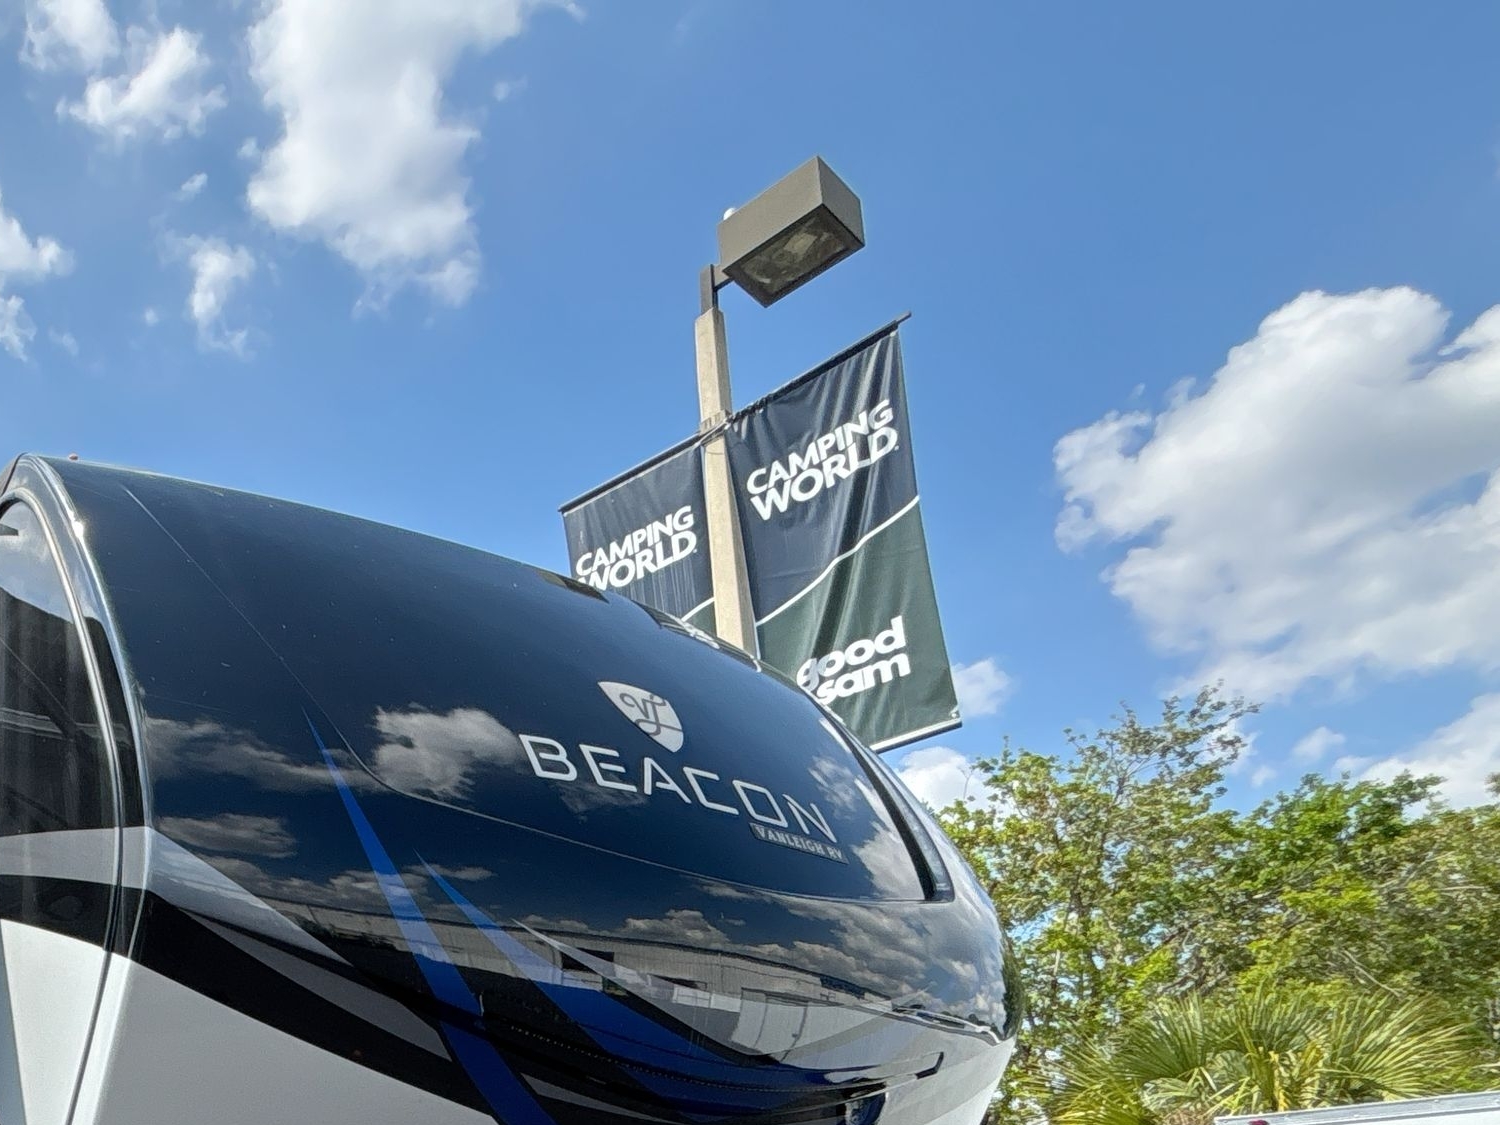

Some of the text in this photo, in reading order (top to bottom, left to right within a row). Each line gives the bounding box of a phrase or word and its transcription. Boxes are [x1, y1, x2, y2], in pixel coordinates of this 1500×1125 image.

[746, 399, 894, 495] CAMPING
[750, 427, 898, 521] WORLD
[575, 505, 695, 577] CAMPING
[577, 530, 697, 591] WORLD
[796, 615, 907, 692] good
[816, 653, 911, 706] sam
[518, 733, 838, 843] BEACON
[755, 826, 843, 860] VANLEIGH RV
